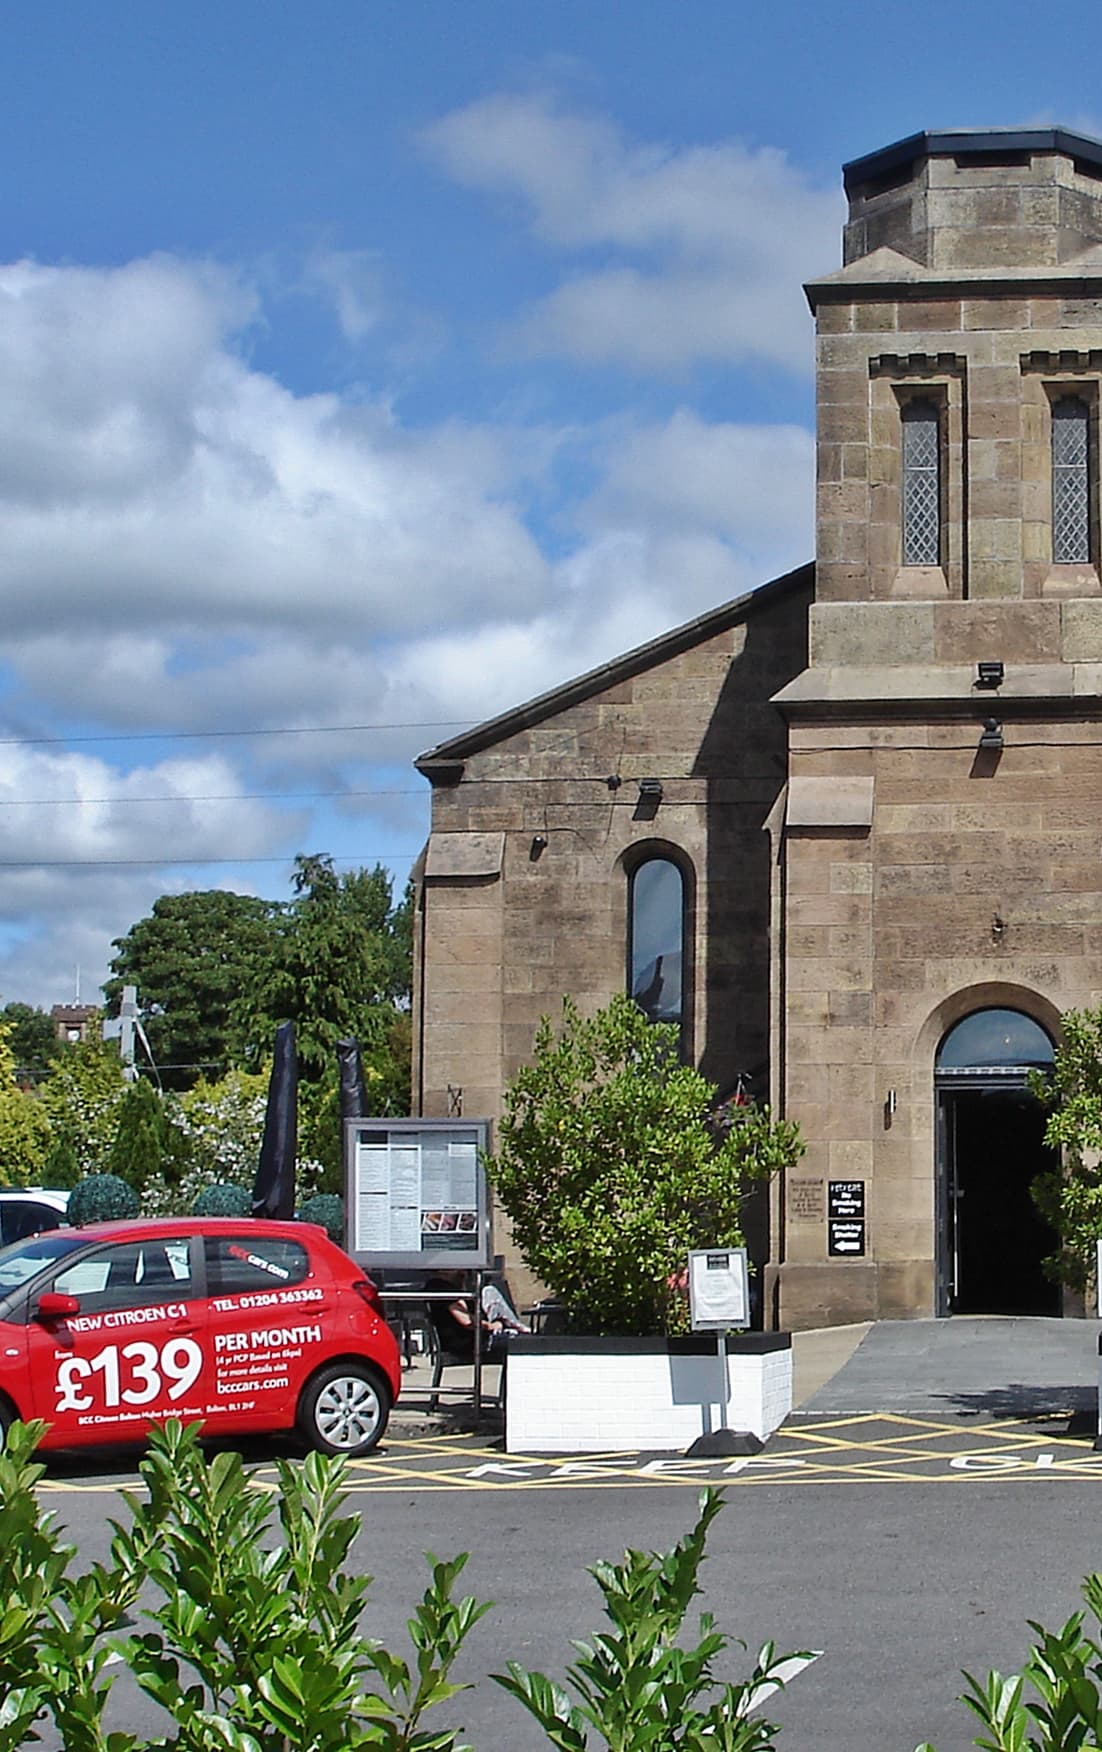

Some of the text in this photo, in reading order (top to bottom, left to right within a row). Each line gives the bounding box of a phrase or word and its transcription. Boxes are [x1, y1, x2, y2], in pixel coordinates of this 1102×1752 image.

[213, 1299, 239, 1312] TEL.
[240, 1293, 279, 1308] 01204
[66, 1303, 188, 1332] NEW CITROEN C1
[214, 1325, 321, 1352] PER MONTH
[55, 1337, 203, 1412] £139
[217, 1377, 288, 1395] bcccars.com
[465, 1459, 806, 1478] KEEP
